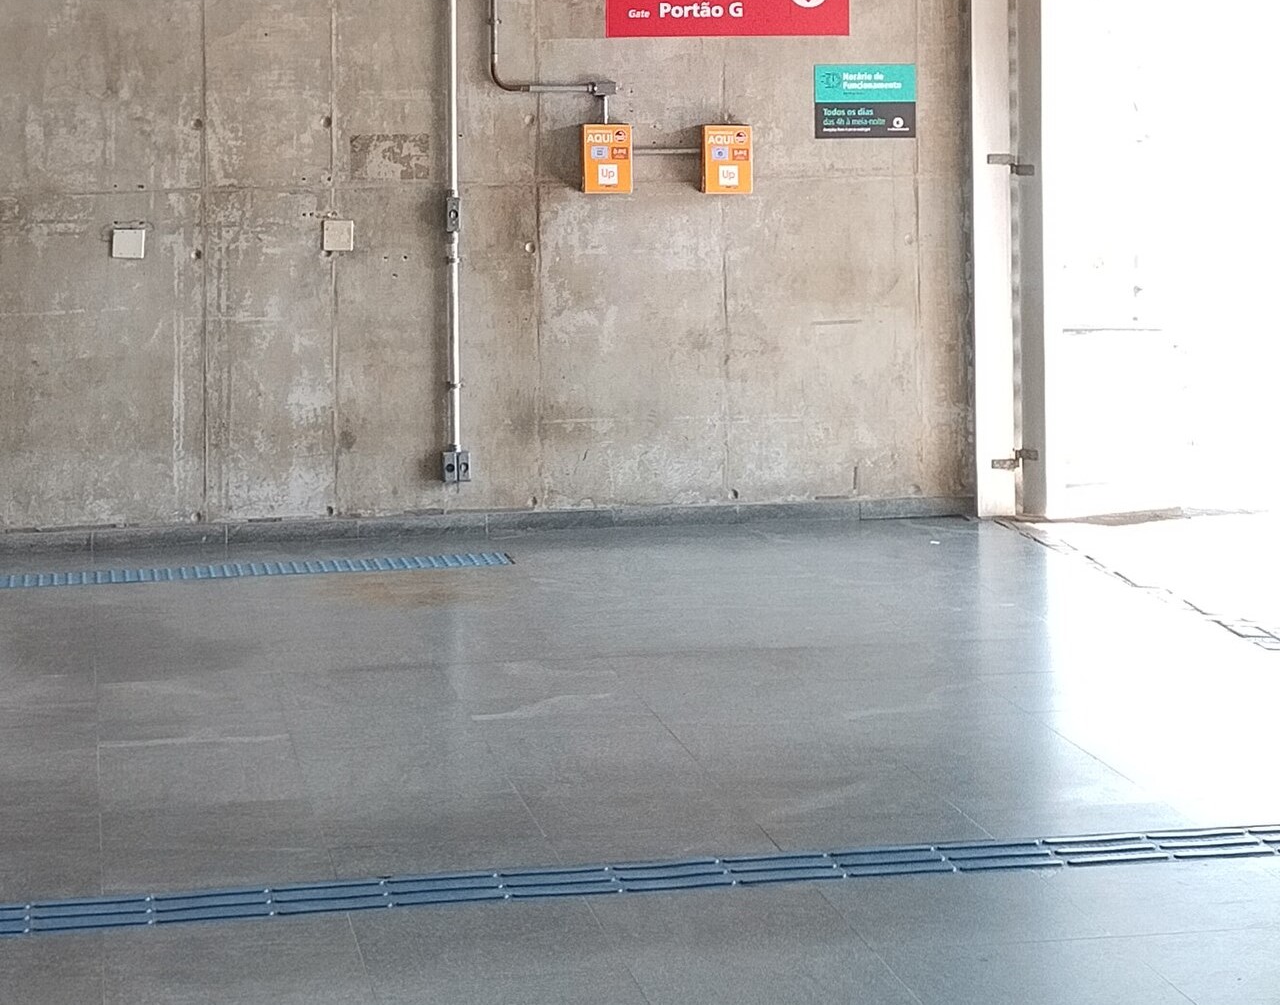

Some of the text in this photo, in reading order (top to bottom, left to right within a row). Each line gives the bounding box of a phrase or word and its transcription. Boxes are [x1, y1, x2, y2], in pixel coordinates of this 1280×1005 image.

[628, 1, 744, 19] Gate Portão G
[842, 72, 884, 81] Horário de
[842, 81, 903, 90] Funcionamento
[822, 108, 846, 116] Todos
[857, 107, 874, 116] dias
[822, 118, 835, 126] das
[587, 133, 613, 143] AQUI
[708, 135, 734, 145] AQUI
[601, 168, 615, 179] Up
[722, 169, 736, 180] Up
